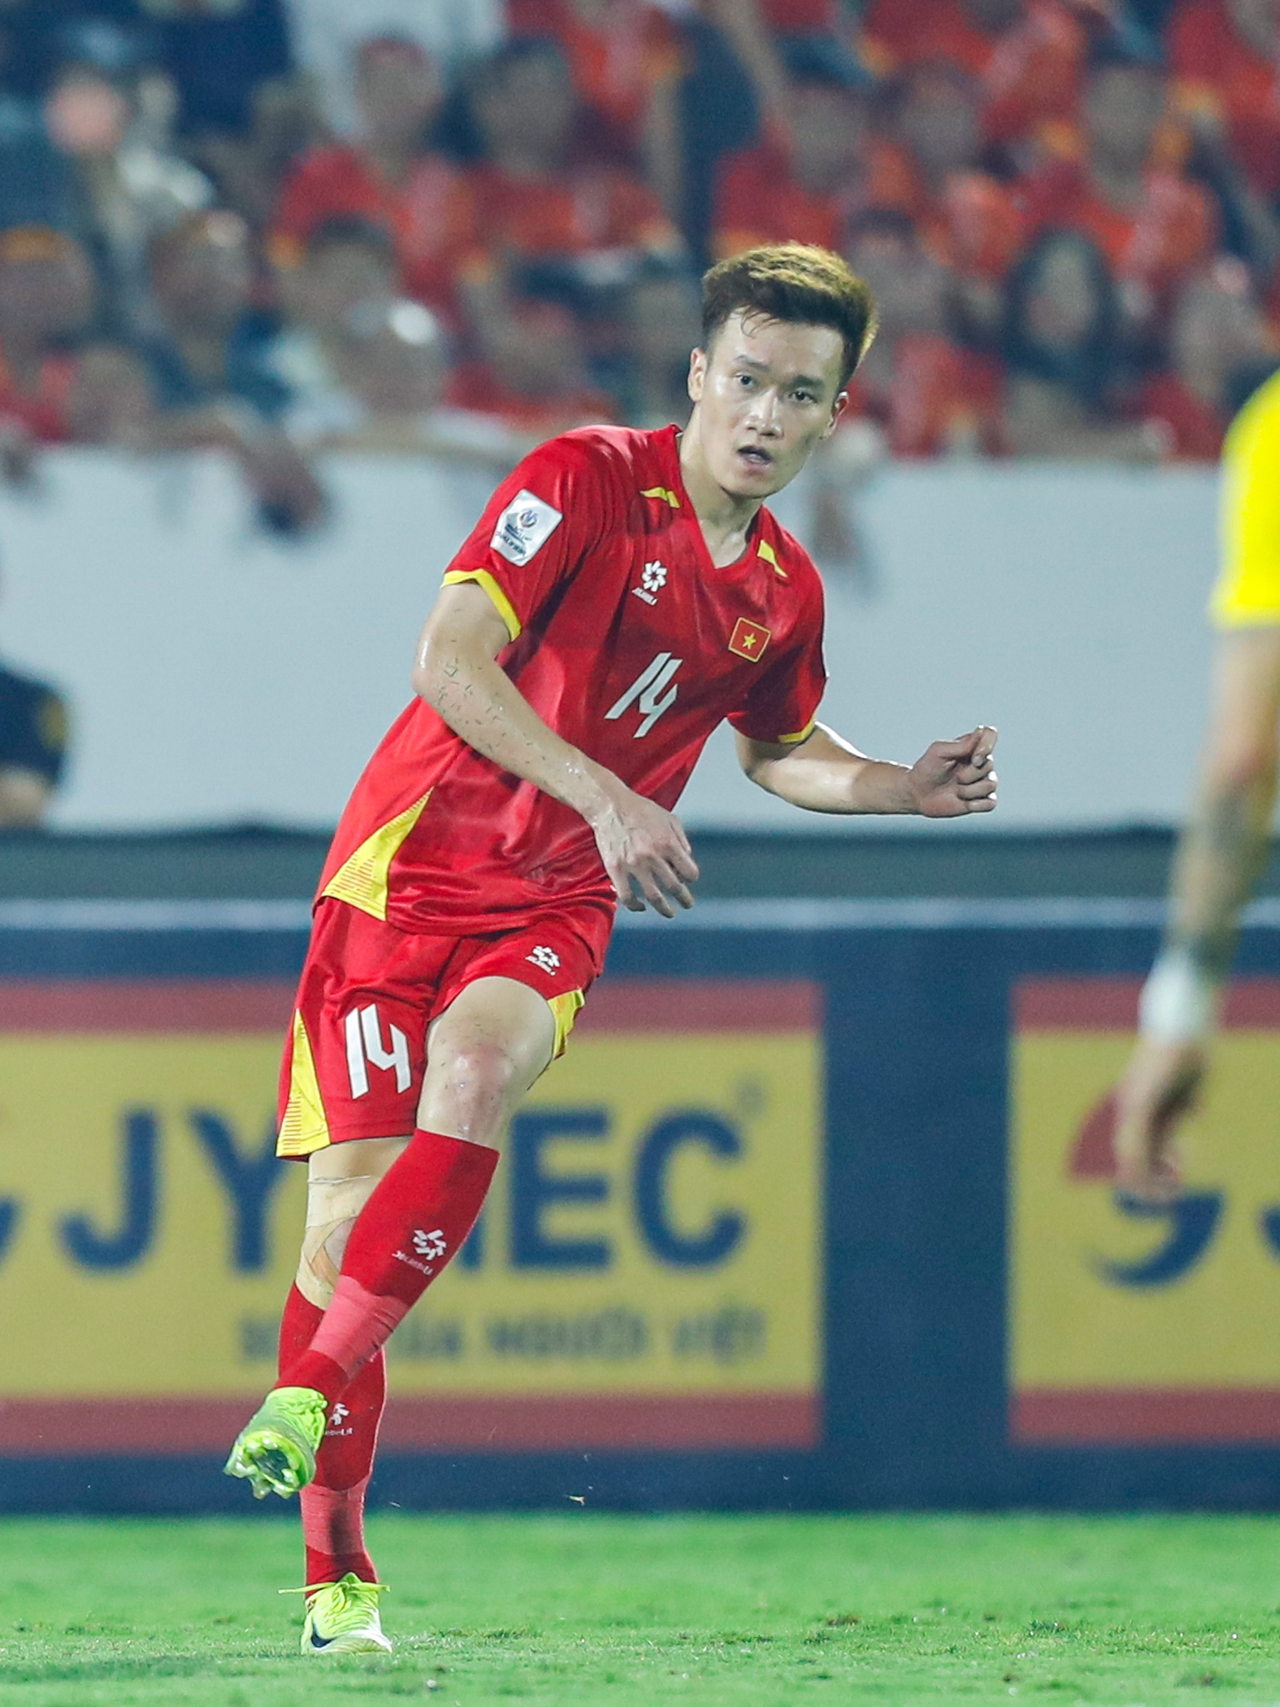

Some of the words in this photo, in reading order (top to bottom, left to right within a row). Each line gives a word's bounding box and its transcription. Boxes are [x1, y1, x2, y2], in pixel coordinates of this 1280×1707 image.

[605, 652, 683, 739] 14
[344, 1003, 412, 1099] 14
[57, 1106, 747, 1275] JYEC
